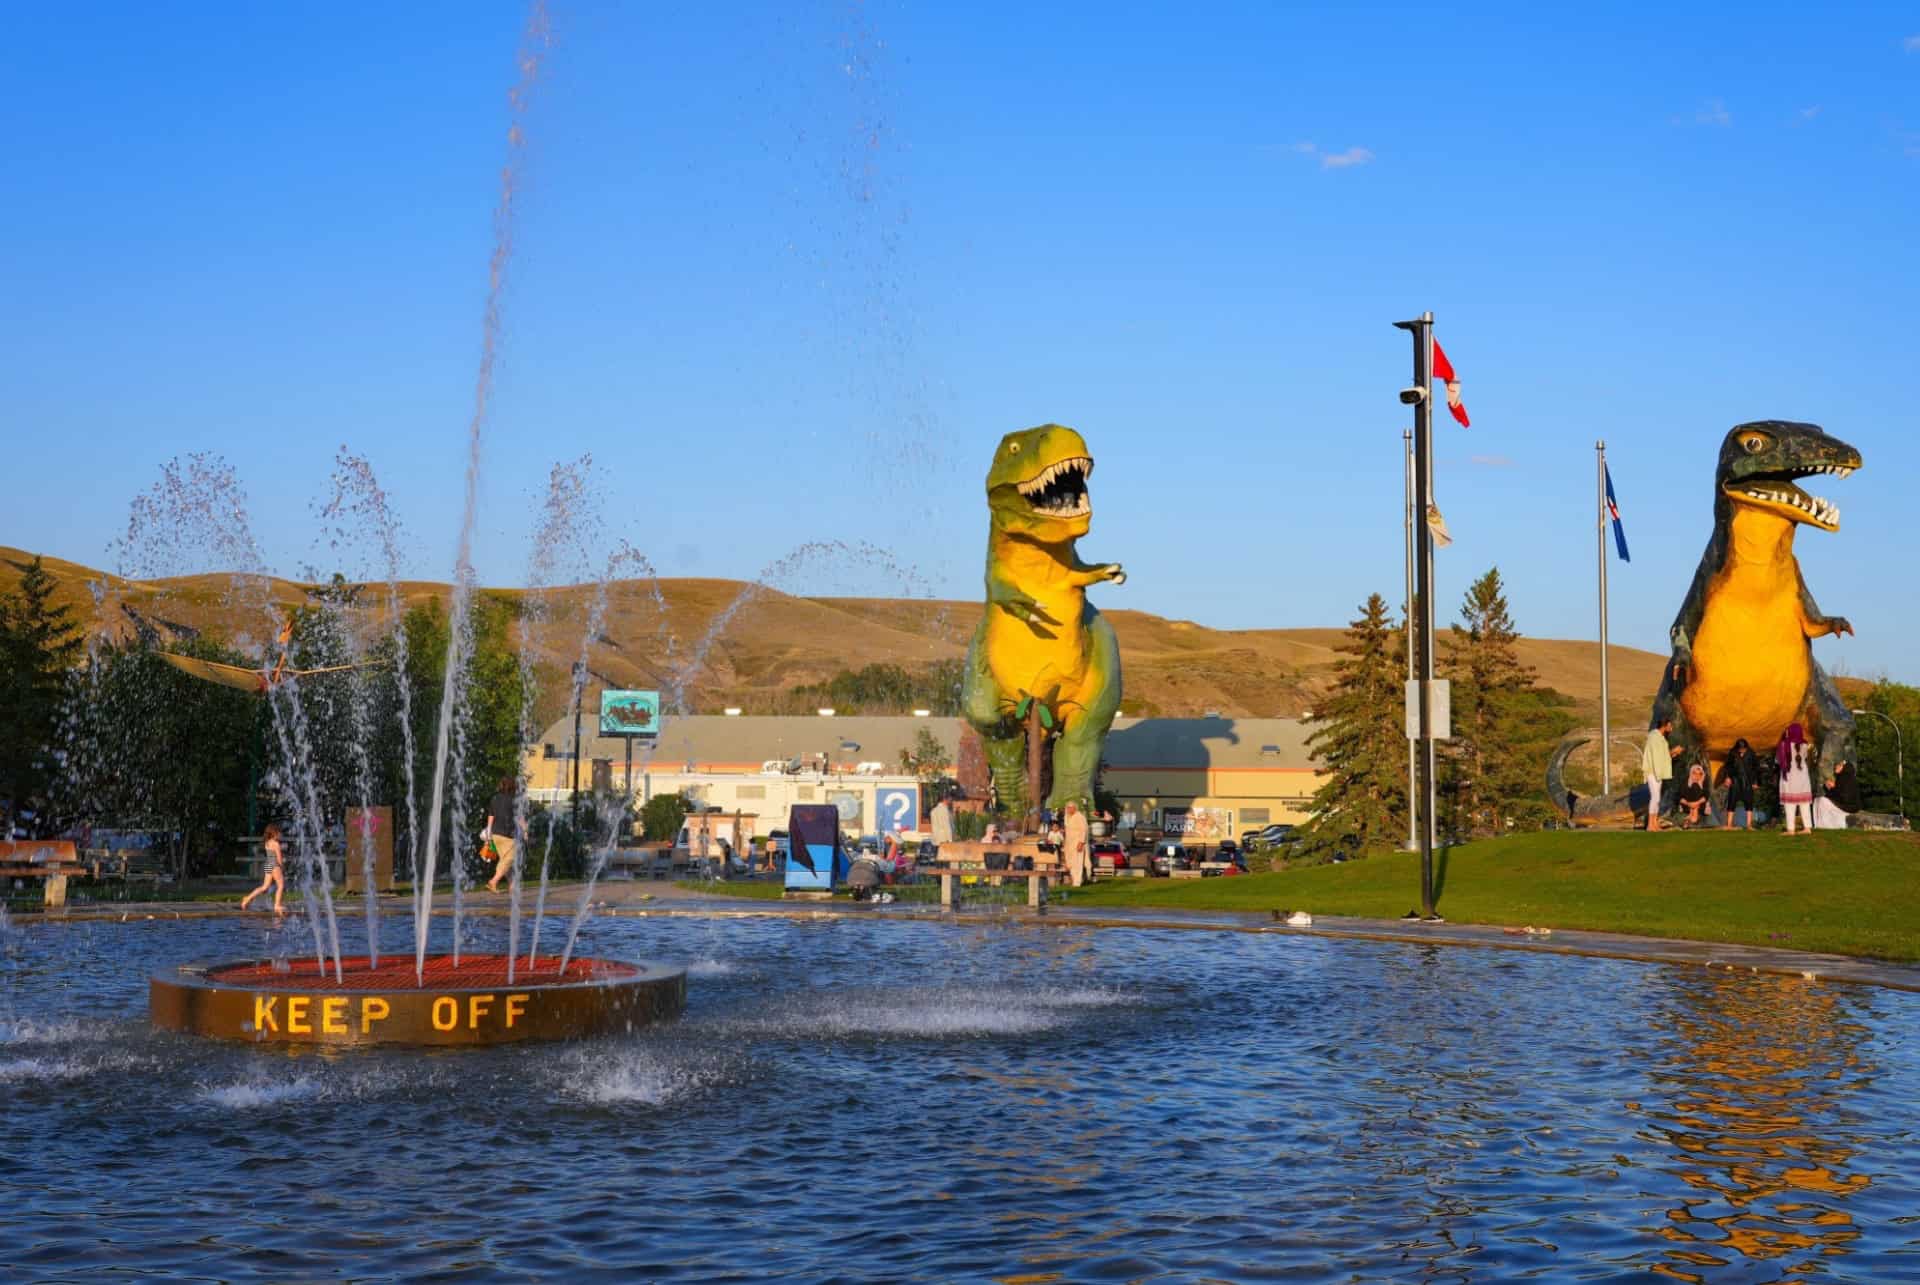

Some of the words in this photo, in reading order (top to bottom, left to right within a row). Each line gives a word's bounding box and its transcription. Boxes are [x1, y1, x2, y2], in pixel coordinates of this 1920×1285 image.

[1164, 823, 1194, 833] PARK
[254, 996, 390, 1034] KEEP
[432, 995, 529, 1031] OFF
